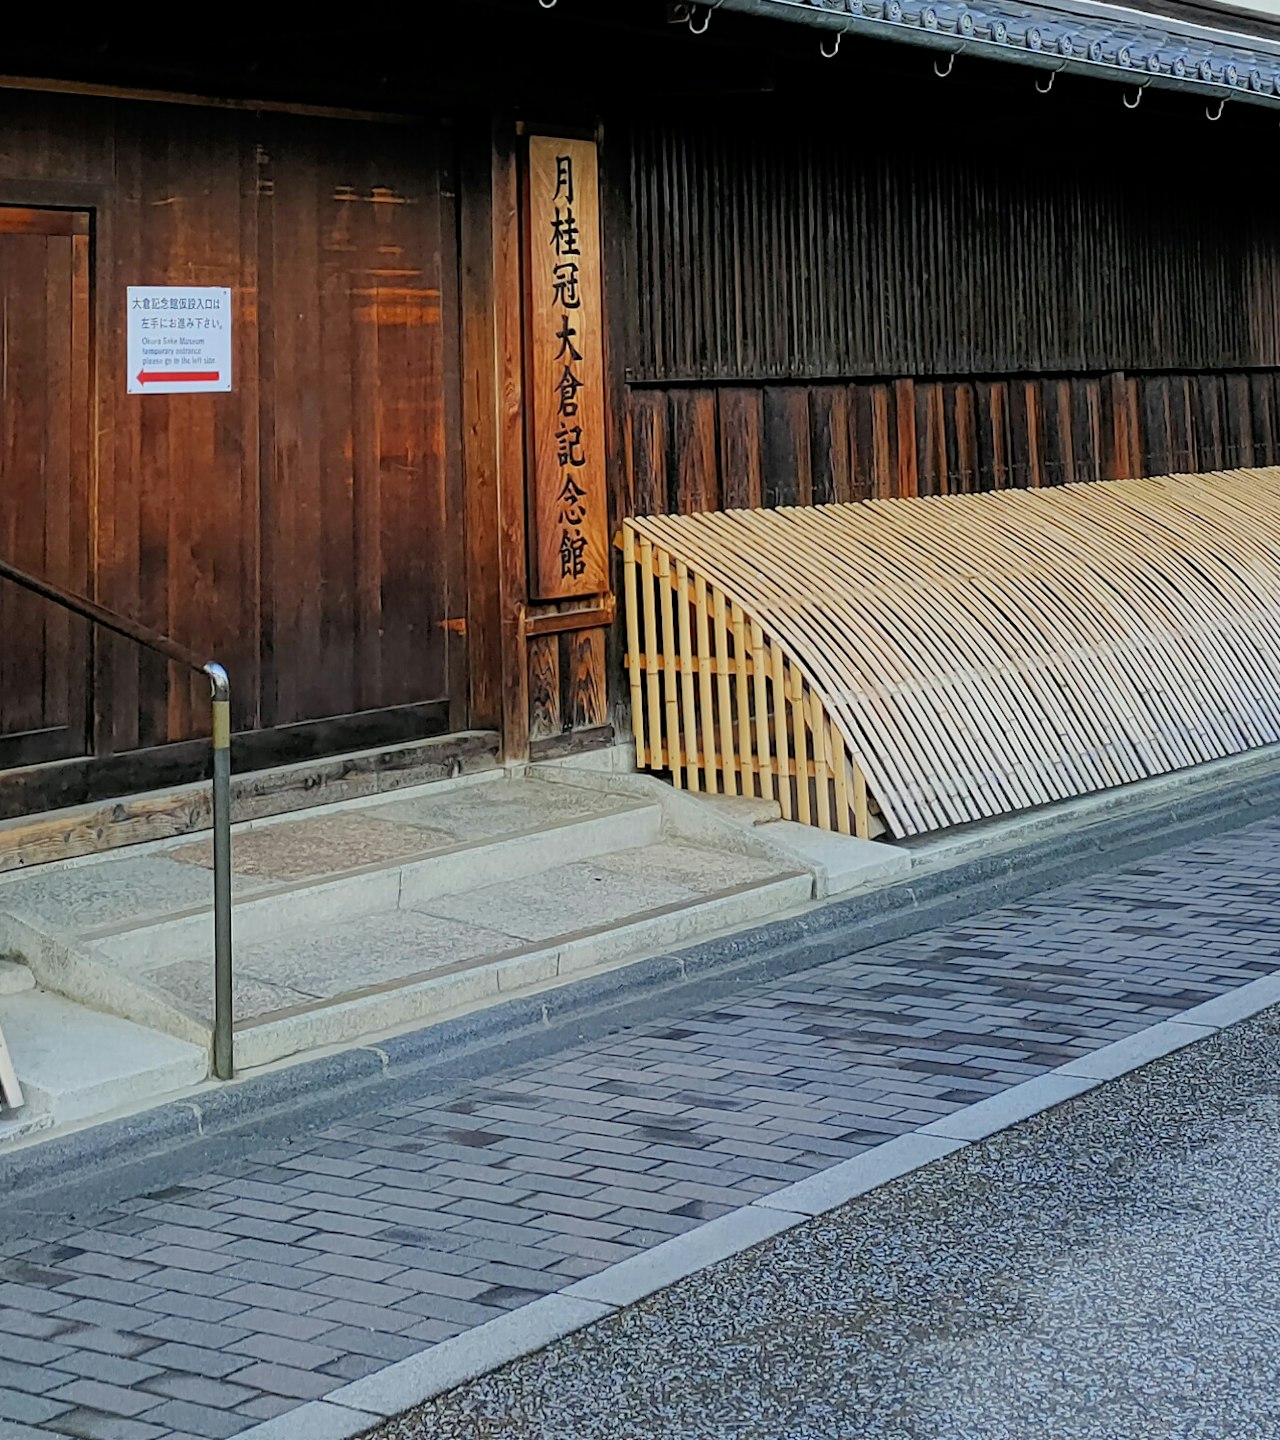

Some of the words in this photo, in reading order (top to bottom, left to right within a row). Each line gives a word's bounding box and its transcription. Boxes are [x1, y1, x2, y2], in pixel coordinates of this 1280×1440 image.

[132, 297, 220, 309] 大倉記念館仮設入口は
[141, 317, 223, 330] 左手にお進み下さい。
[549, 155, 588, 580] 月桂冠大倉記念館
